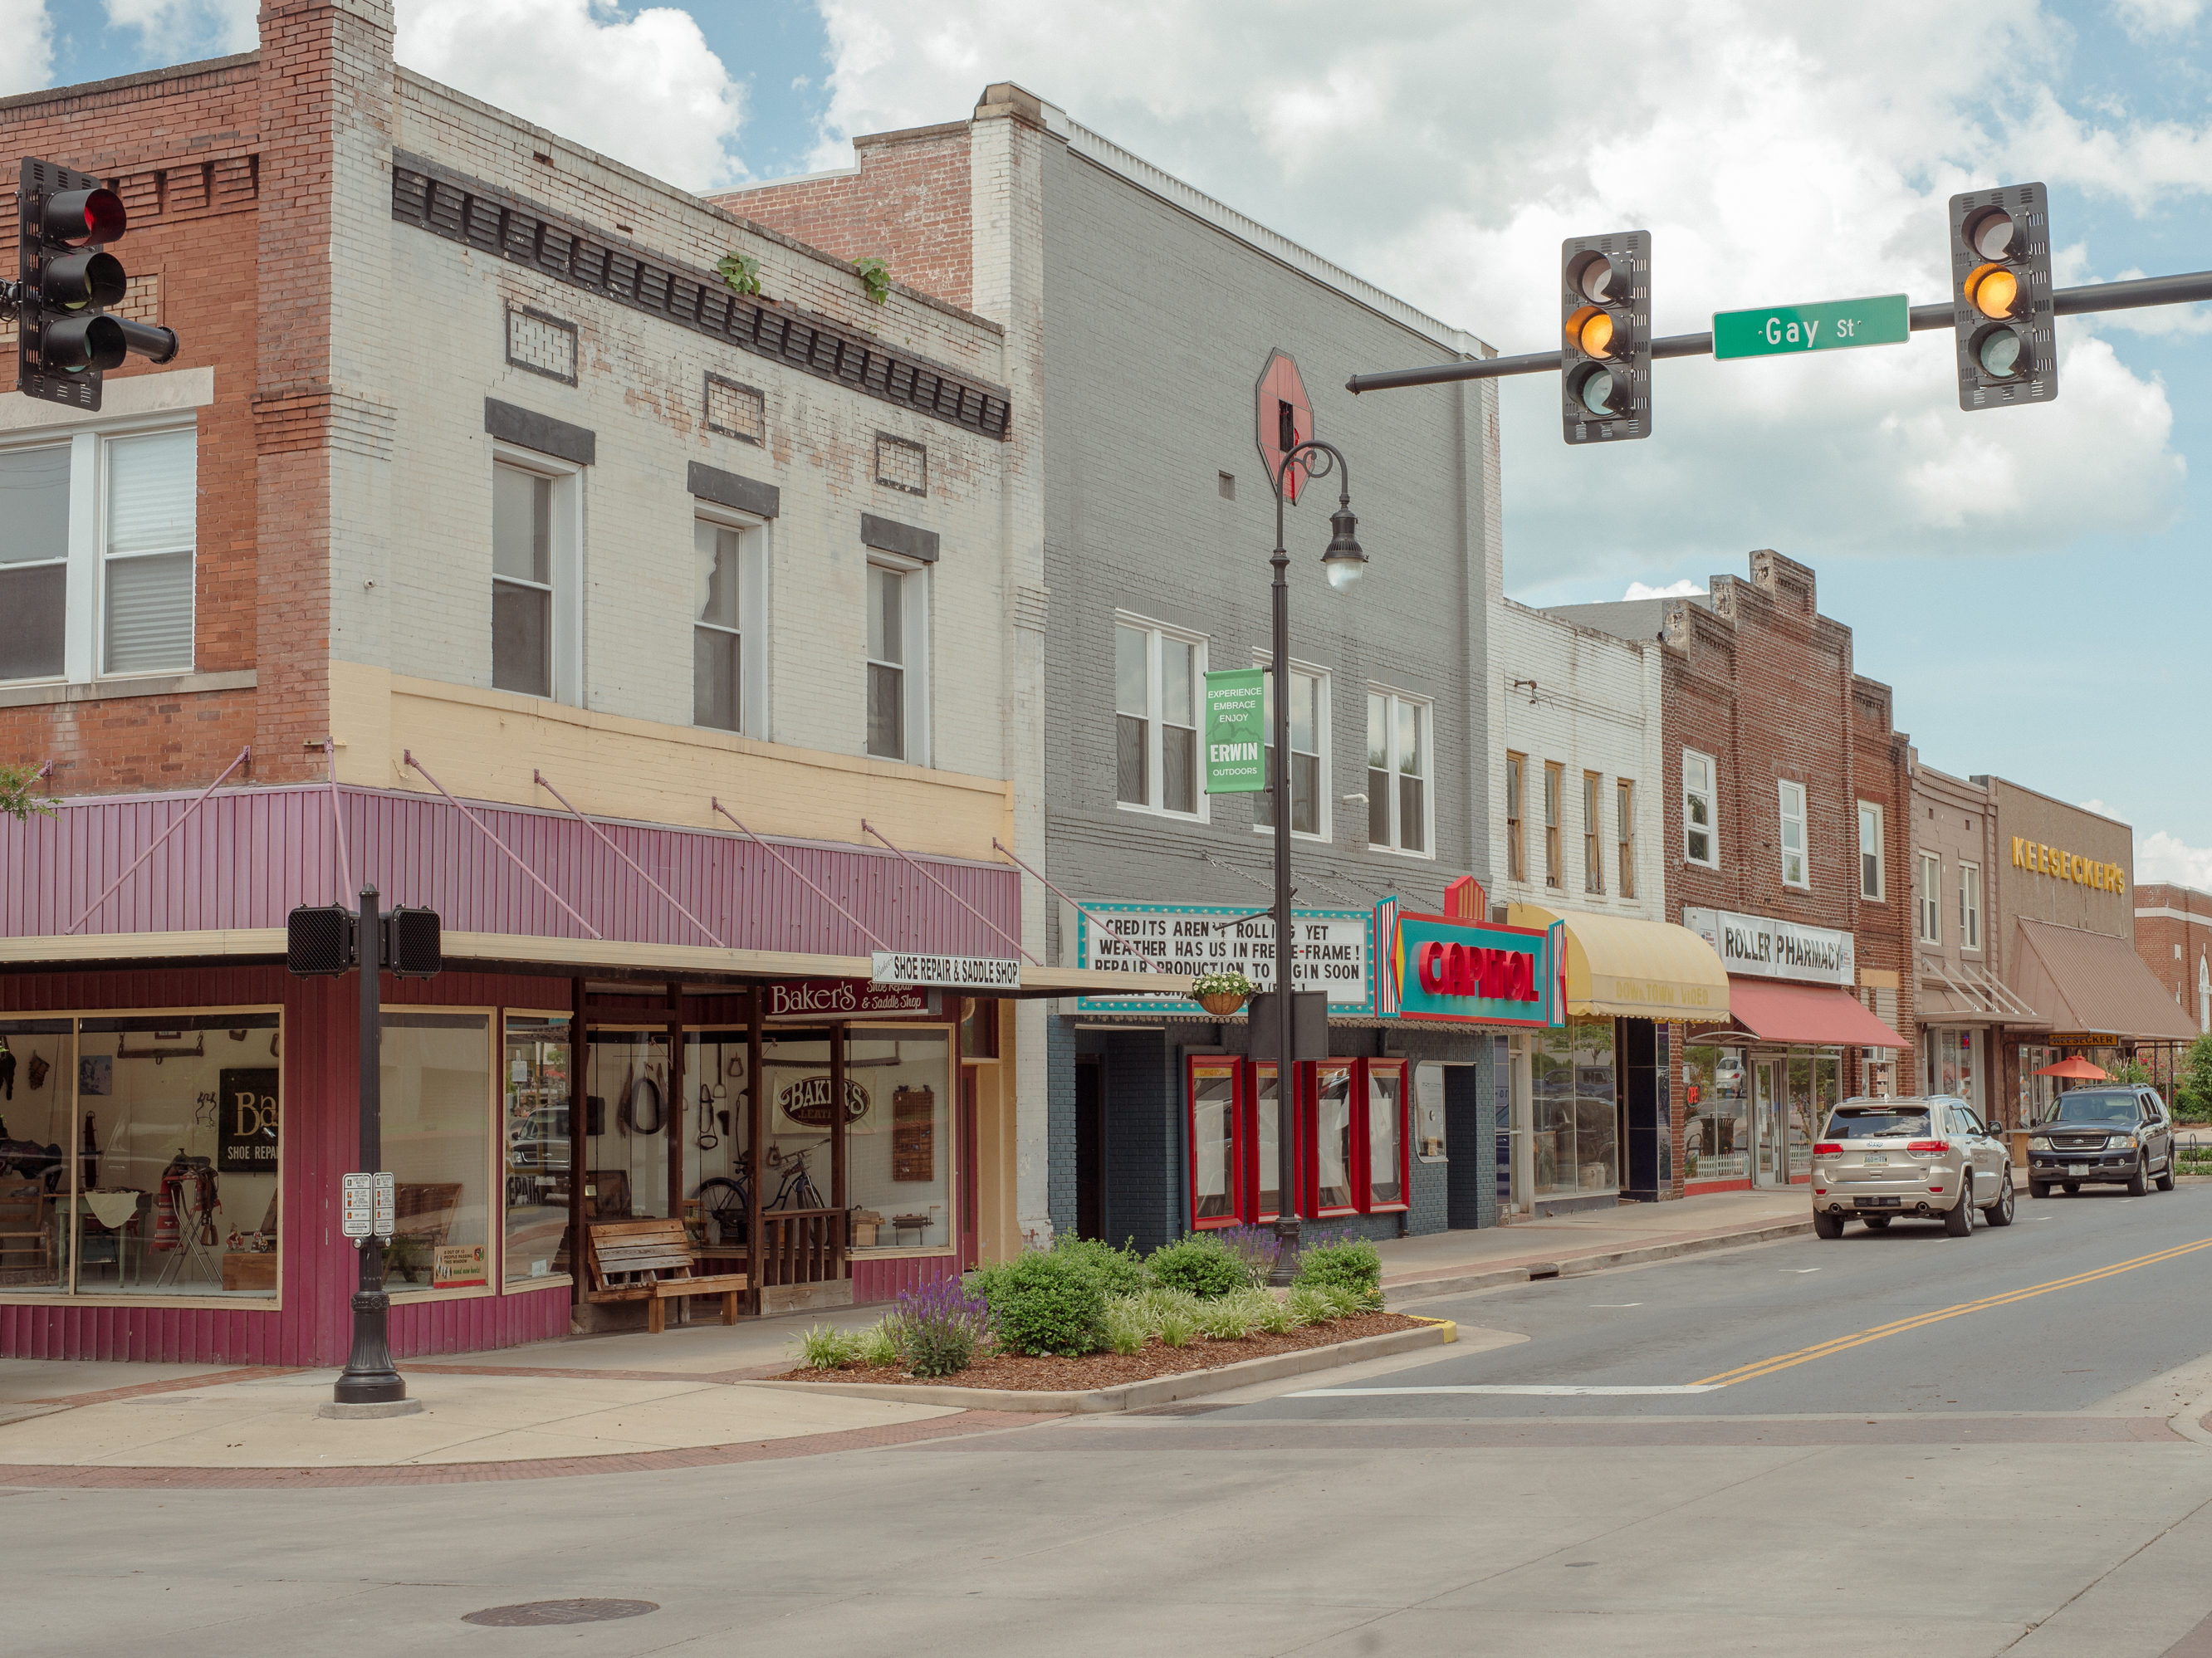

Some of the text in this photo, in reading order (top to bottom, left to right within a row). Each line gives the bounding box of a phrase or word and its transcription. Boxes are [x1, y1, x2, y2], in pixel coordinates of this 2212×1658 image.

[1766, 317, 1854, 348] Gay St
[1208, 687, 1262, 698] EXPERIENCE
[1214, 701, 1255, 710] EMBRACE
[1219, 714, 1249, 722] ENJOY
[1210, 742, 1258, 762] ERWIN
[1212, 767, 1257, 776] OUTDOORS
[2012, 836, 2126, 894] KEESECKER'S
[1106, 919, 1166, 936] CREDITS
[1236, 923, 1295, 939] ROLLIG
[1306, 925, 1329, 941] YET
[1099, 939, 1167, 956] WEATHER
[1176, 941, 1203, 956] HAS
[1210, 941, 1226, 956] US
[1234, 942, 1247, 957] IN
[1725, 927, 1771, 963] ROLLER
[1776, 935, 1841, 971] PHARMACY
[894, 955, 918, 980] SHOE
[921, 957, 951, 981] REPAIR
[953, 959, 960, 981] &
[962, 960, 994, 983] SADDLE
[996, 961, 1018, 984] SHOP
[1253, 963, 1270, 978] TO
[1324, 964, 1359, 979] SOON
[1419, 941, 1539, 1002] CAPITOL
[866, 980, 888, 993] Shoe
[1681, 986, 1709, 1005] VIDEO
[771, 981, 857, 1014] Baker's
[862, 994, 922, 1010] & Saddle Shop
[228, 1146, 250, 1160] SHOE
[507, 1176, 549, 1206] EPAIR
